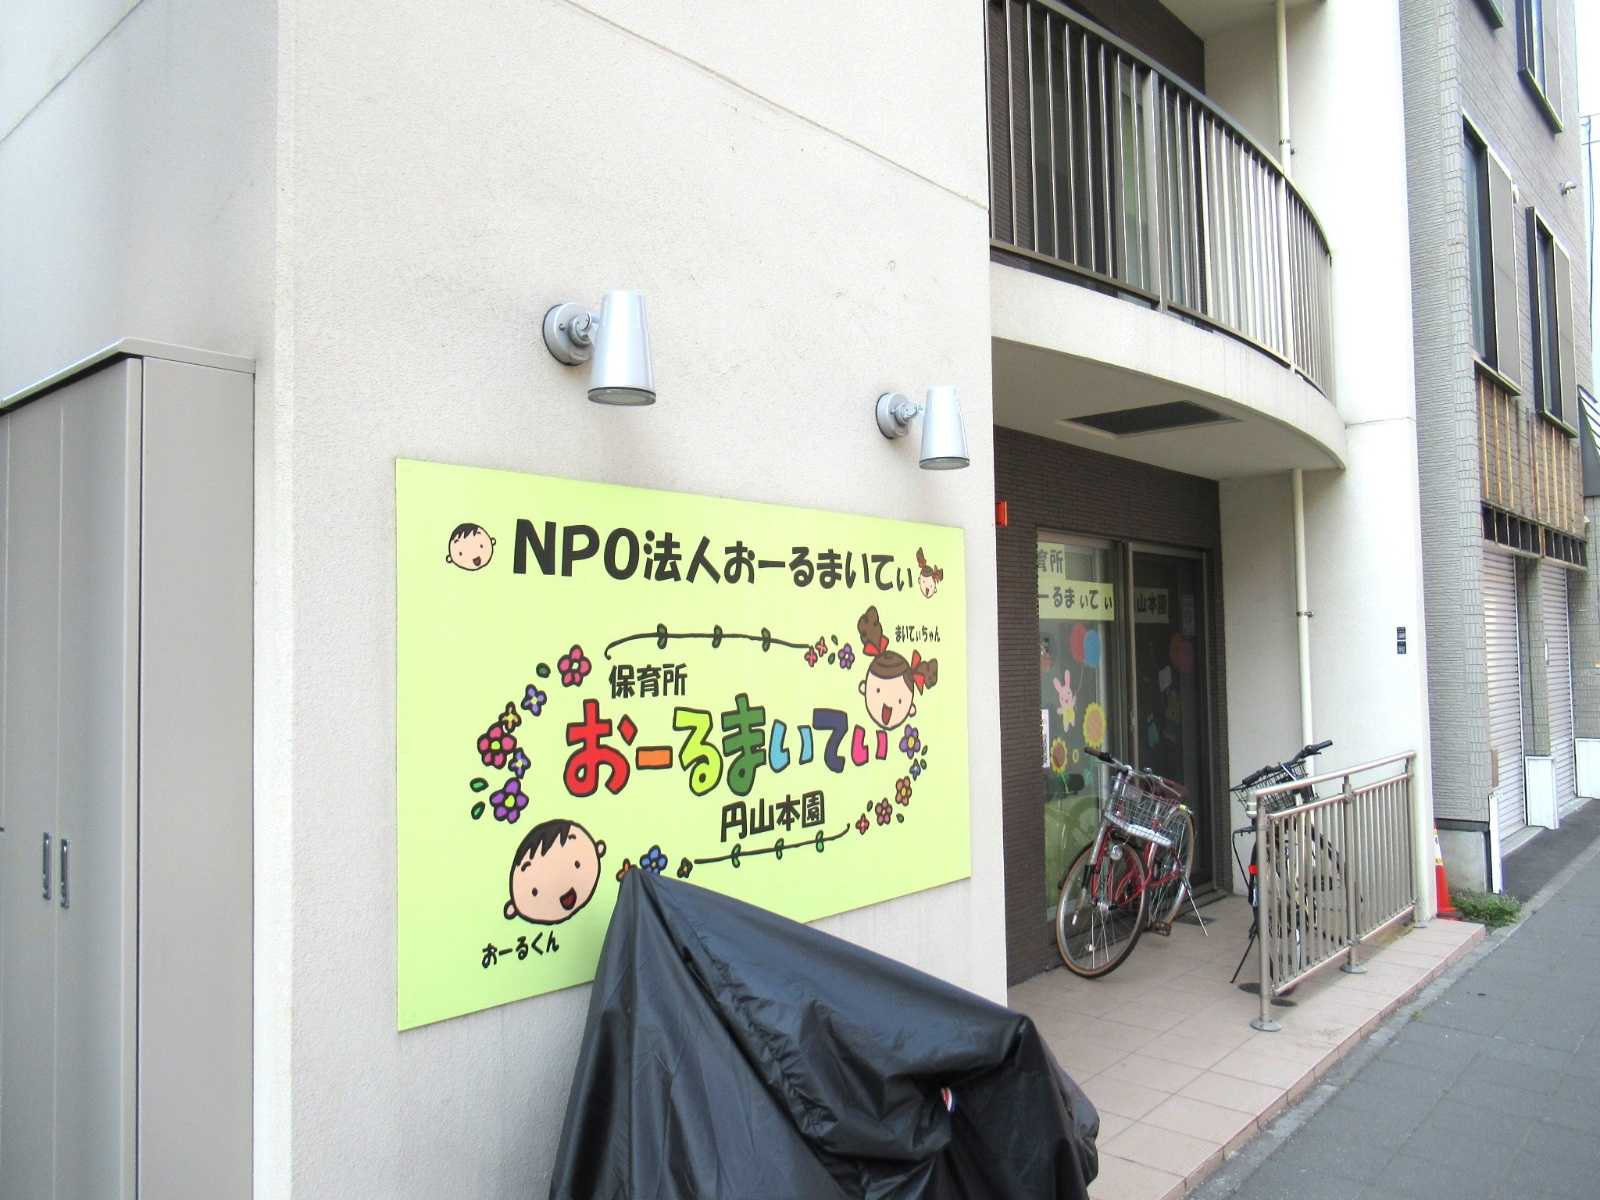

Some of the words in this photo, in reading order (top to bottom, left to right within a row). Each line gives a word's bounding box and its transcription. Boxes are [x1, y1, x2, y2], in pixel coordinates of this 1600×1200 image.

[609, 664, 687, 698] 保育所
[720, 790, 825, 842] 円山本園
[481, 930, 560, 968] おーるくん
